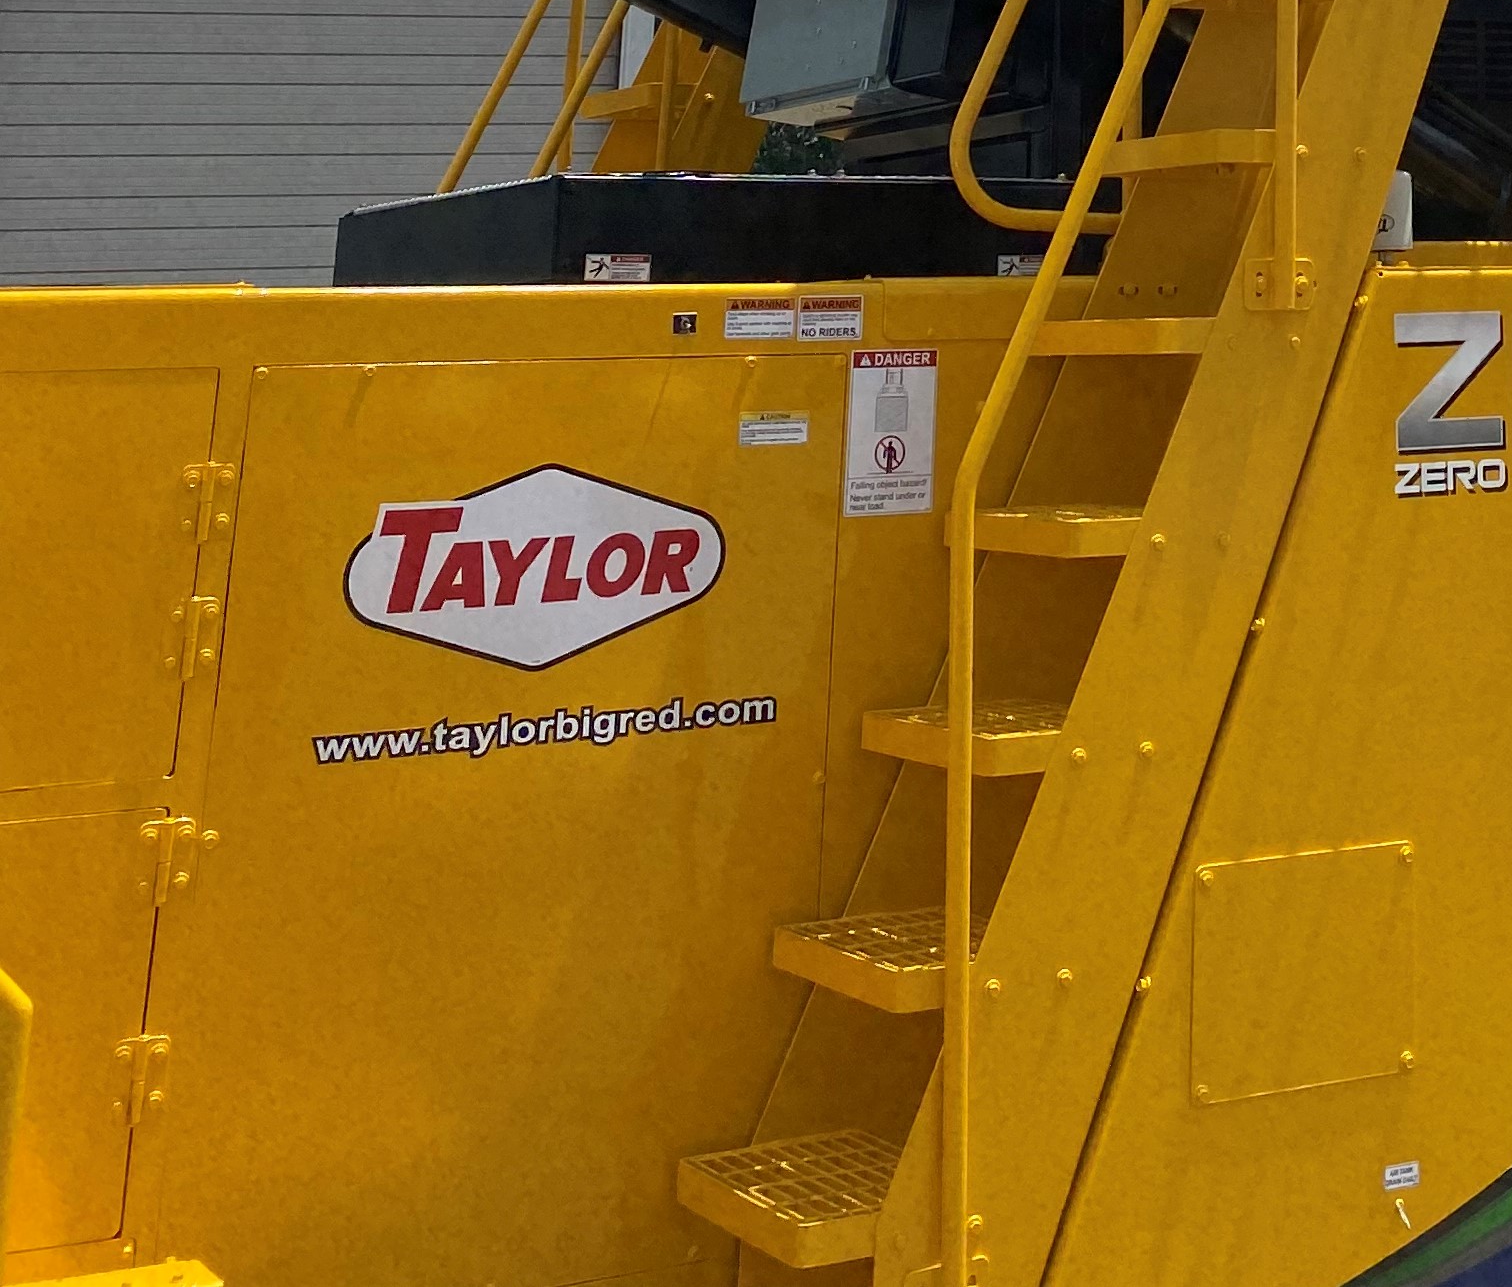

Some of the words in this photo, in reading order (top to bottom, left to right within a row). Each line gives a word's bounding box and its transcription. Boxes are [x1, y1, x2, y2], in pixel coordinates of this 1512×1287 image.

[740, 299, 791, 310] WARNING
[811, 299, 860, 310] WARNING
[801, 327, 817, 338] NO
[818, 326, 857, 337] RIDERS
[874, 352, 931, 366] DANGER
[1394, 458, 1508, 498] ZERO
[850, 481, 875, 490] Falling
[849, 494, 872, 502] Never
[380, 507, 700, 614] TAYLOR
[313, 695, 777, 765] www.taylorbigred.com
